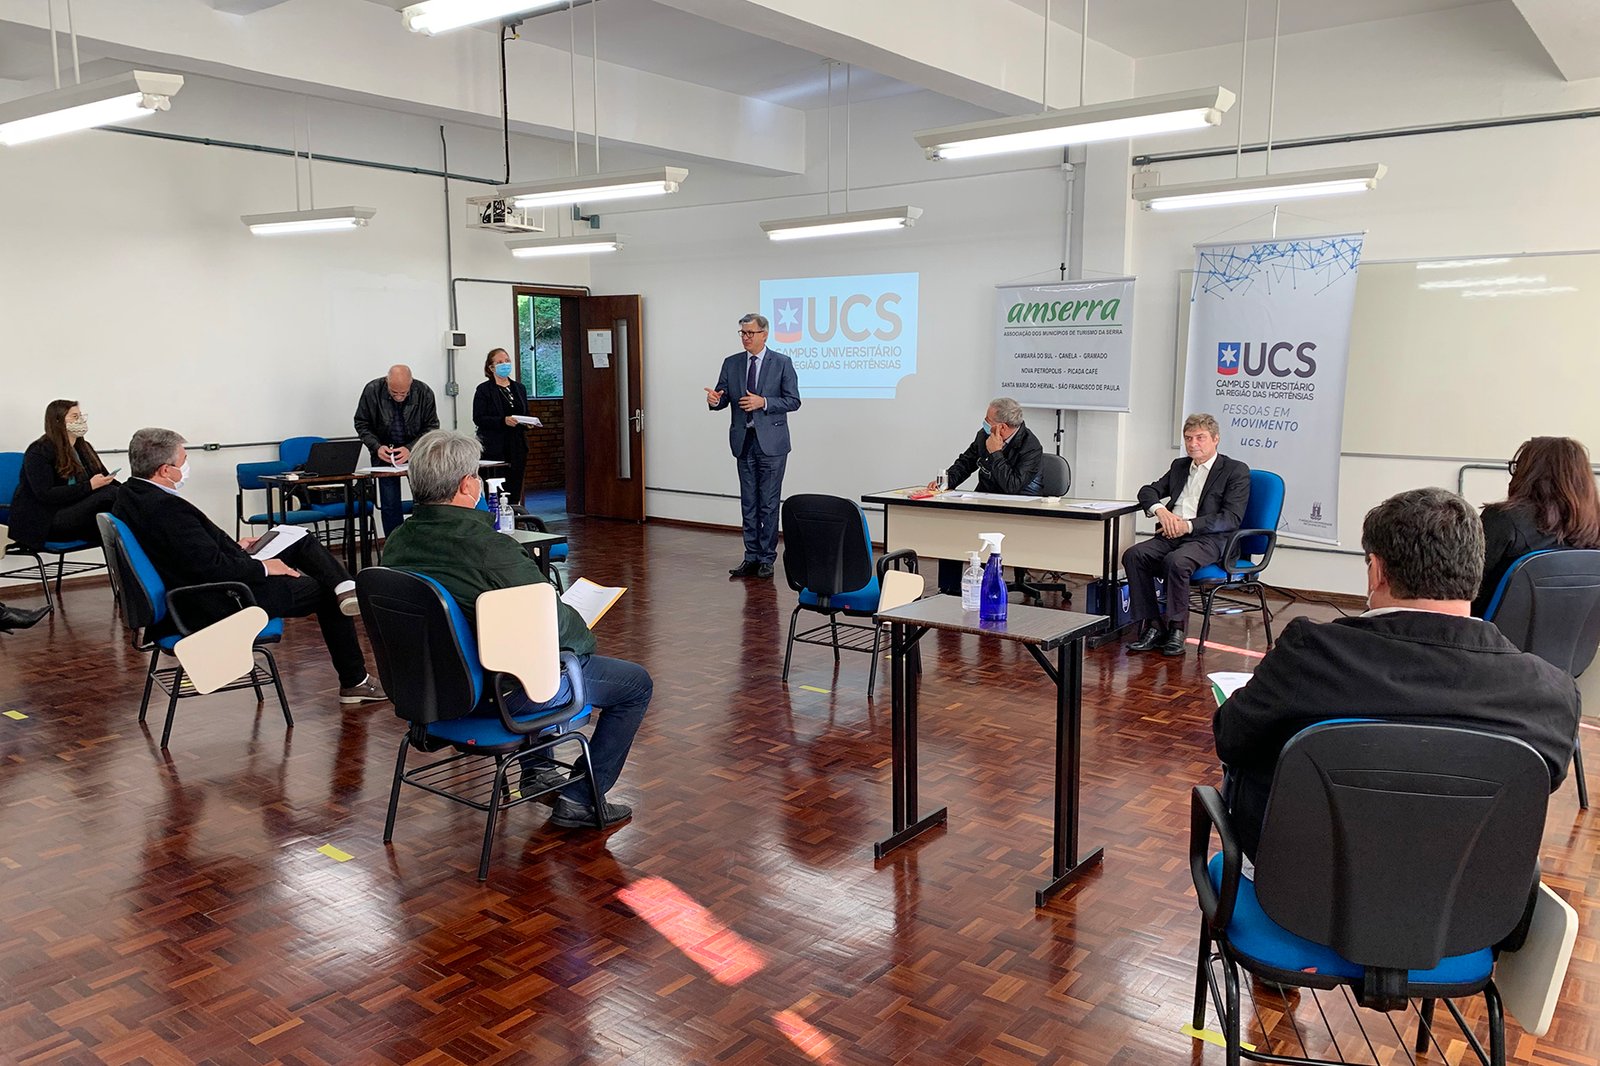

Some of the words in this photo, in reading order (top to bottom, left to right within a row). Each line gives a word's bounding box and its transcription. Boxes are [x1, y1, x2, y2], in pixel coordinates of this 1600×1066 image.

[808, 292, 902, 343] UCS
[1007, 298, 1121, 323] amserra
[821, 344, 902, 358] UNIVERSITÁRIO
[793, 359, 820, 370] EGIÃO
[822, 360, 841, 370] DAS
[843, 358, 902, 370] HORTÊNSIAS
[1243, 341, 1317, 379] UCS
[1216, 379, 1250, 389] CAMPUS
[1252, 380, 1315, 392] UNIVERSITÁRIO
[1226, 389, 1252, 398] REGIÃO
[1252, 390, 1268, 398] DAS
[1269, 390, 1314, 401] HORTÊNSIAS
[1222, 404, 1270, 417] PESSOAS
[1273, 406, 1291, 418] EM
[1230, 417, 1298, 432] MOVIMENTO
[1240, 437, 1278, 449] ucs.br
